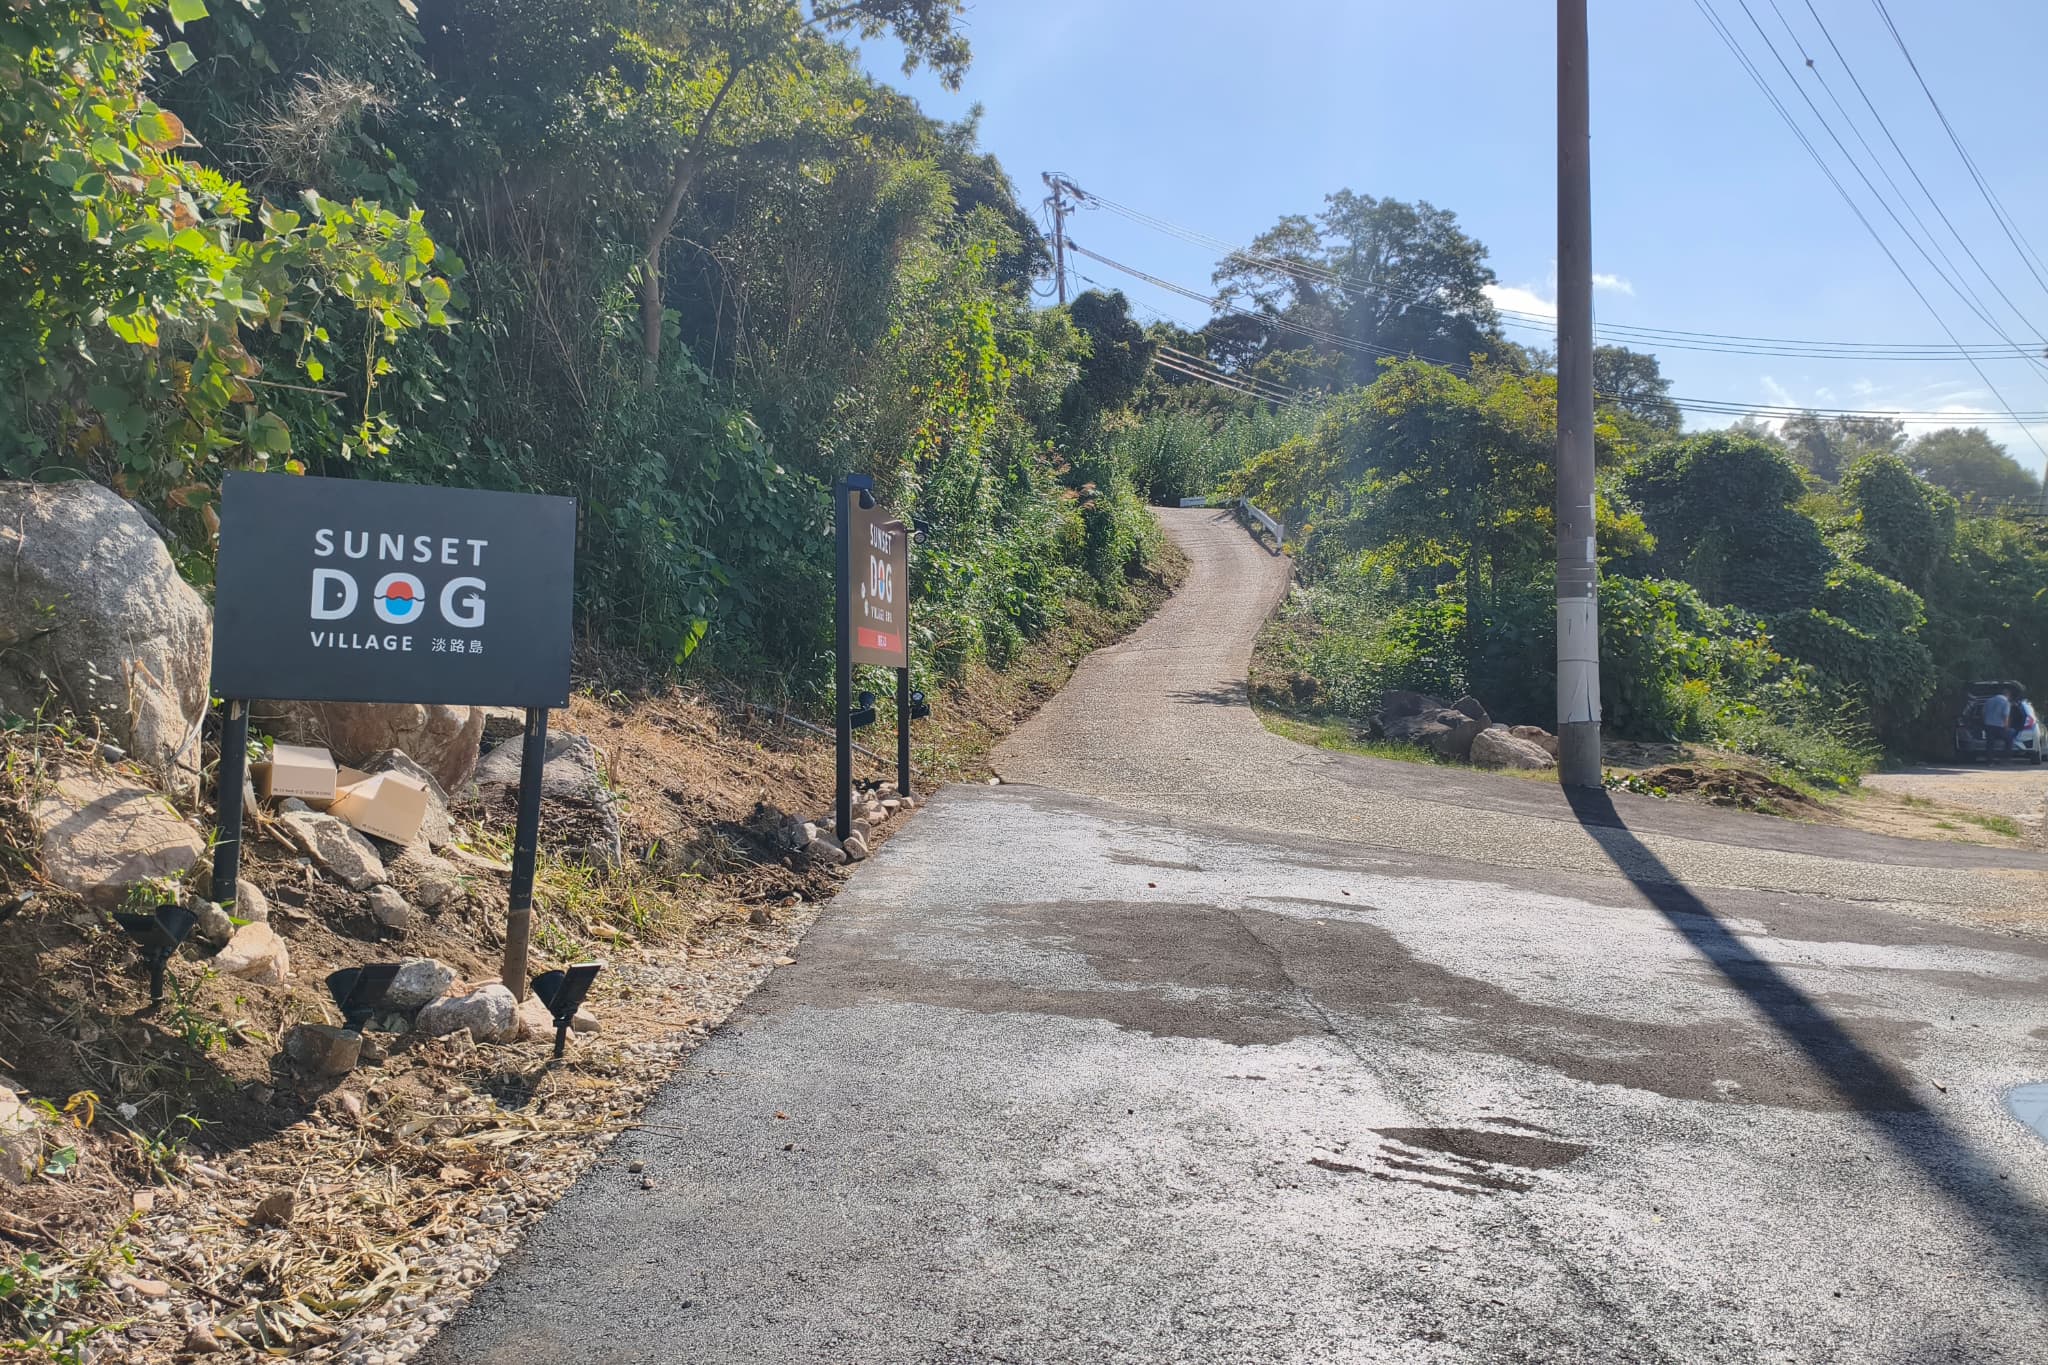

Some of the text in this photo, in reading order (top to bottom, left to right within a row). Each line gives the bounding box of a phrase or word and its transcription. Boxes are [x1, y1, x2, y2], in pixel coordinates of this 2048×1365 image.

[314, 529, 488, 566] SUNSET
[870, 523, 892, 555] SUNSET
[870, 555, 893, 603] DOG
[311, 568, 486, 628] DOG
[310, 631, 484, 654] VILLAGE 淡路島
